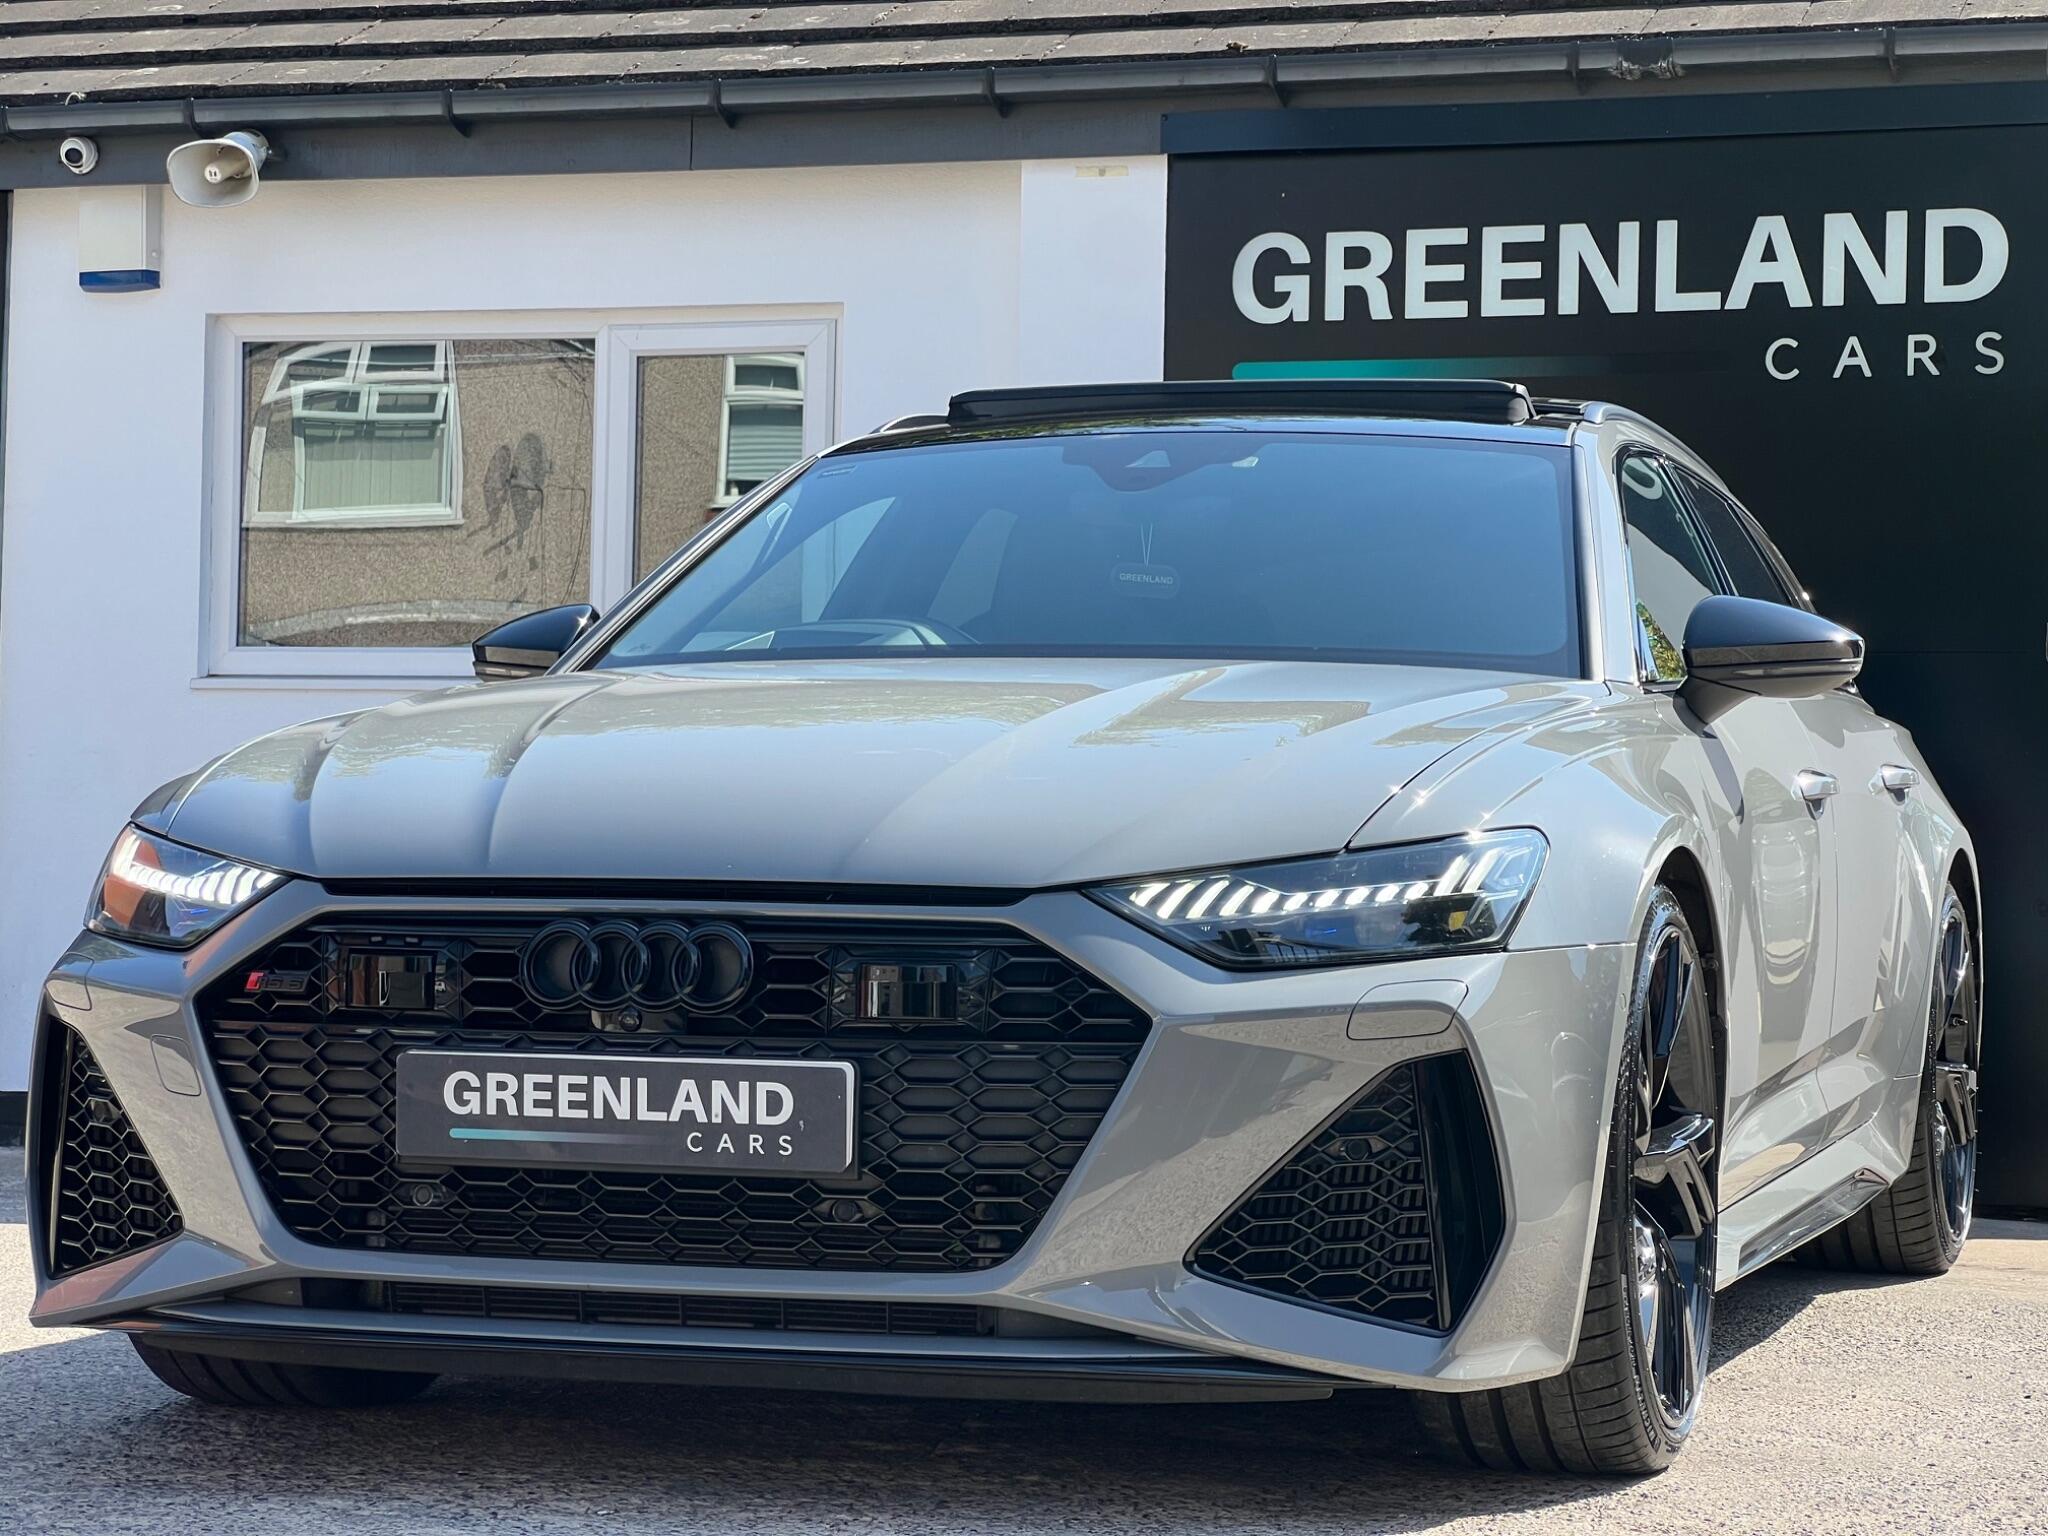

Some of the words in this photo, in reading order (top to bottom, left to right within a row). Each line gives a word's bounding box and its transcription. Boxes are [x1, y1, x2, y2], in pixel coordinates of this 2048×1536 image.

[1232, 207, 2009, 325] GREENLAND
[1765, 331, 2004, 381] CARS
[1119, 572, 1174, 585] GREENLAND
[443, 1070, 794, 1126] GREENLAND
[686, 1131, 793, 1156] CARS
